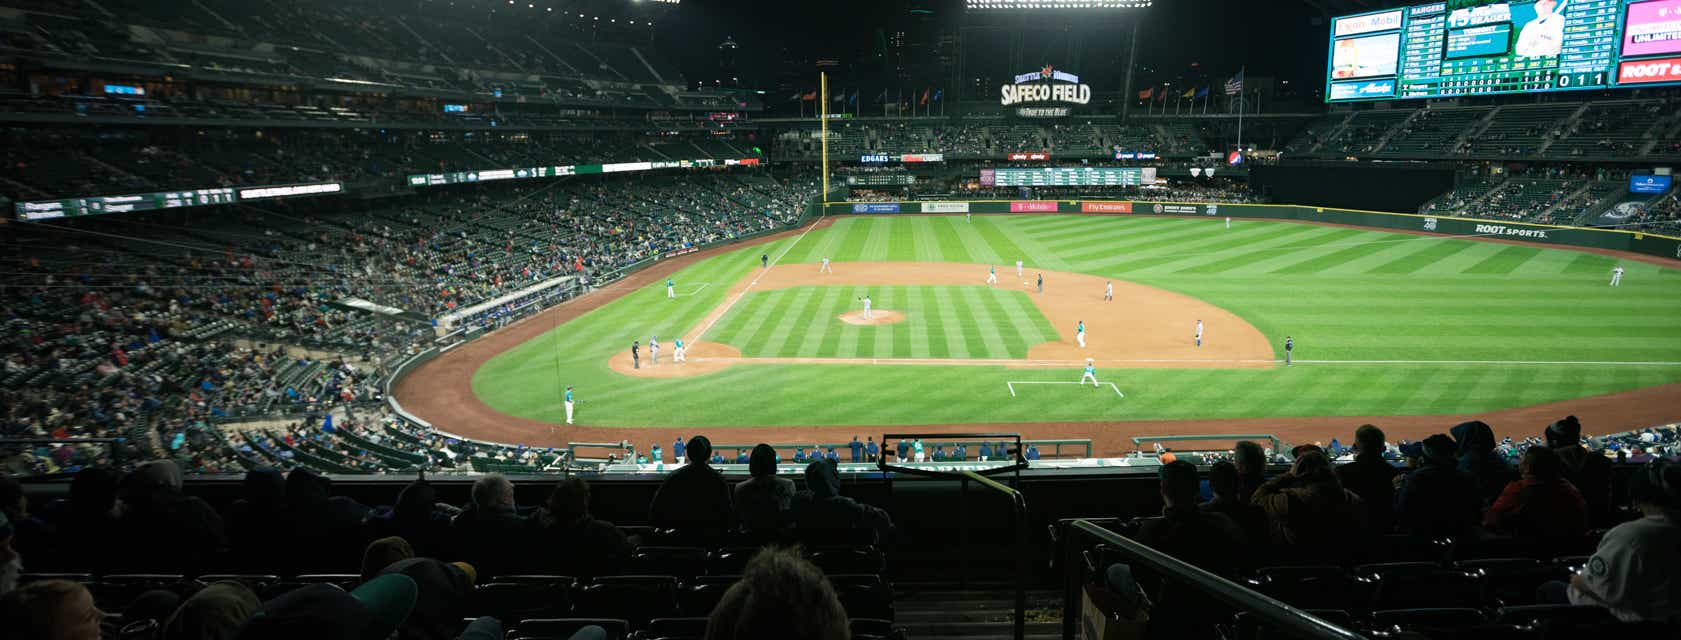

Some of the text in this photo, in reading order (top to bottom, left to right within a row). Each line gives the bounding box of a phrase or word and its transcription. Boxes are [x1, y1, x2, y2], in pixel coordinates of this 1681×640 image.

[1411, 4, 1445, 15] RANGERS
[1371, 14, 1398, 26] Mobil
[1447, 9, 1469, 28] 15
[1622, 63, 1671, 78] ROOT
[1559, 73, 1602, 86] 0 1 1
[1001, 84, 1091, 105] SAFECO FIELD
[1088, 203, 1100, 212] Fly
[1475, 224, 1545, 238] ROOT SPORTS
